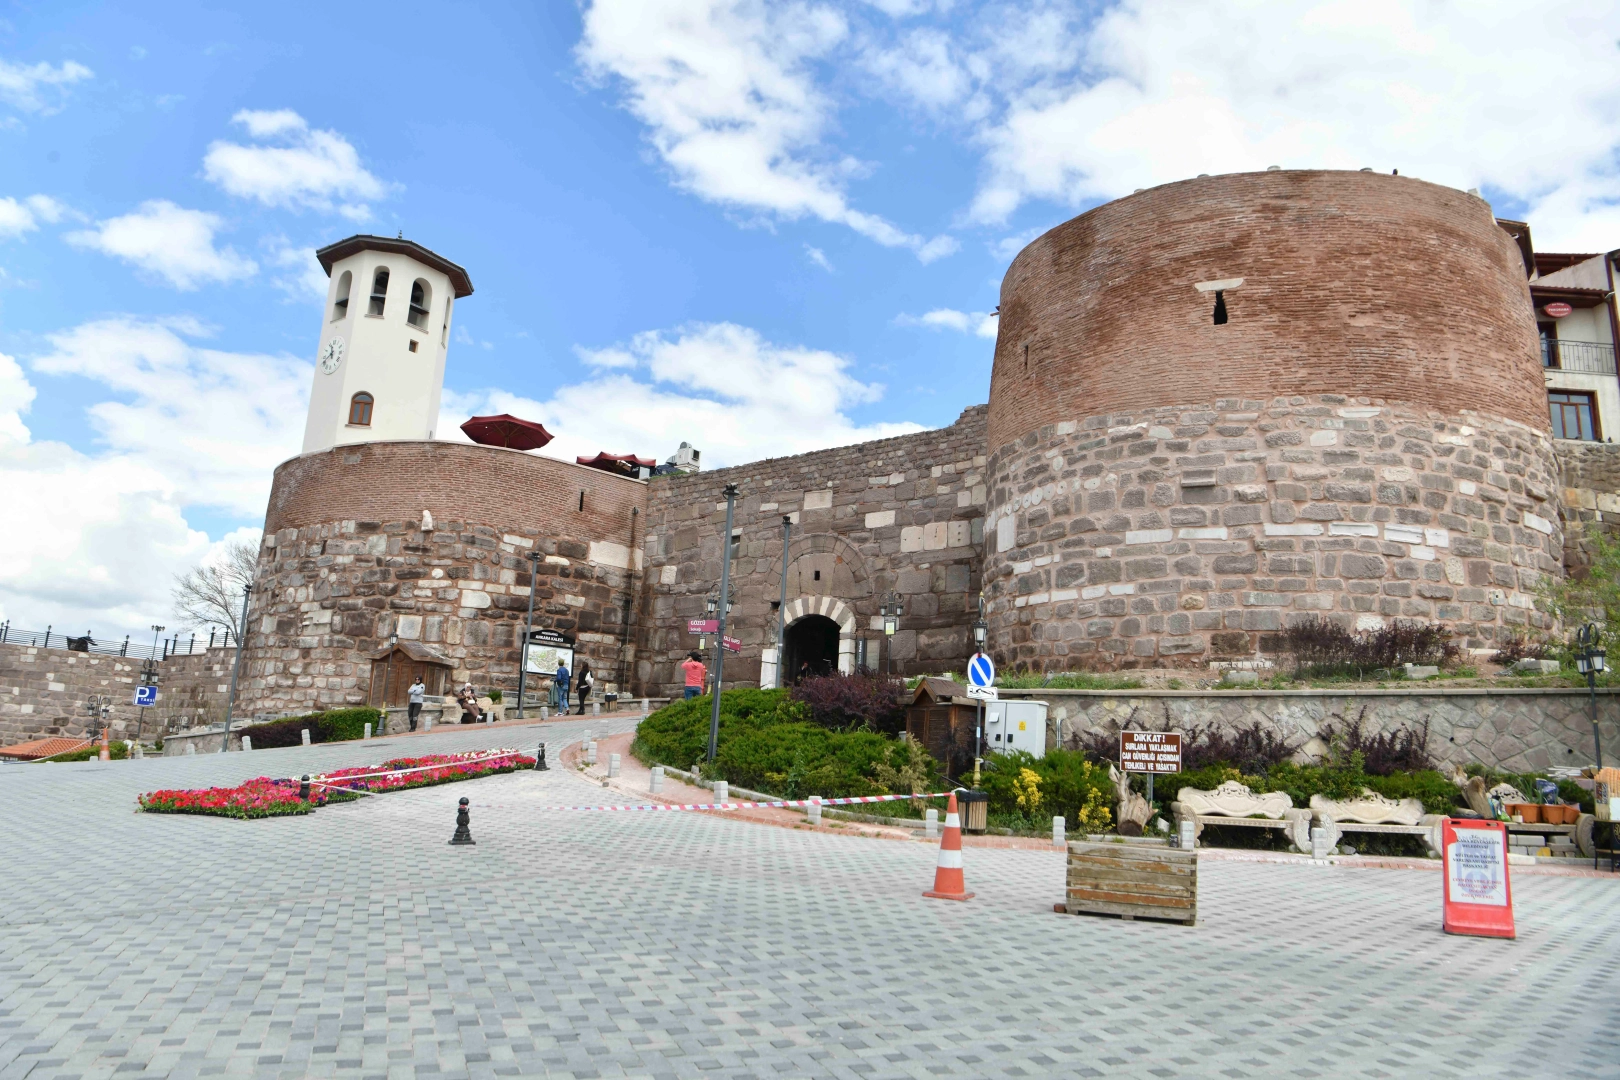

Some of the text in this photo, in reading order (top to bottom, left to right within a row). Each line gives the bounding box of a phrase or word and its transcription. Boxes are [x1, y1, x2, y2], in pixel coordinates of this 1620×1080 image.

[135, 686, 150, 704] P
[1125, 743, 1178, 752] SURLARA YAKLAŞMAK
[1122, 751, 1180, 763] CAN GÜVENLİĞİ AÇISINDAN
[1124, 762, 1177, 771] TEHLİKELİ VE YASAKTIR
